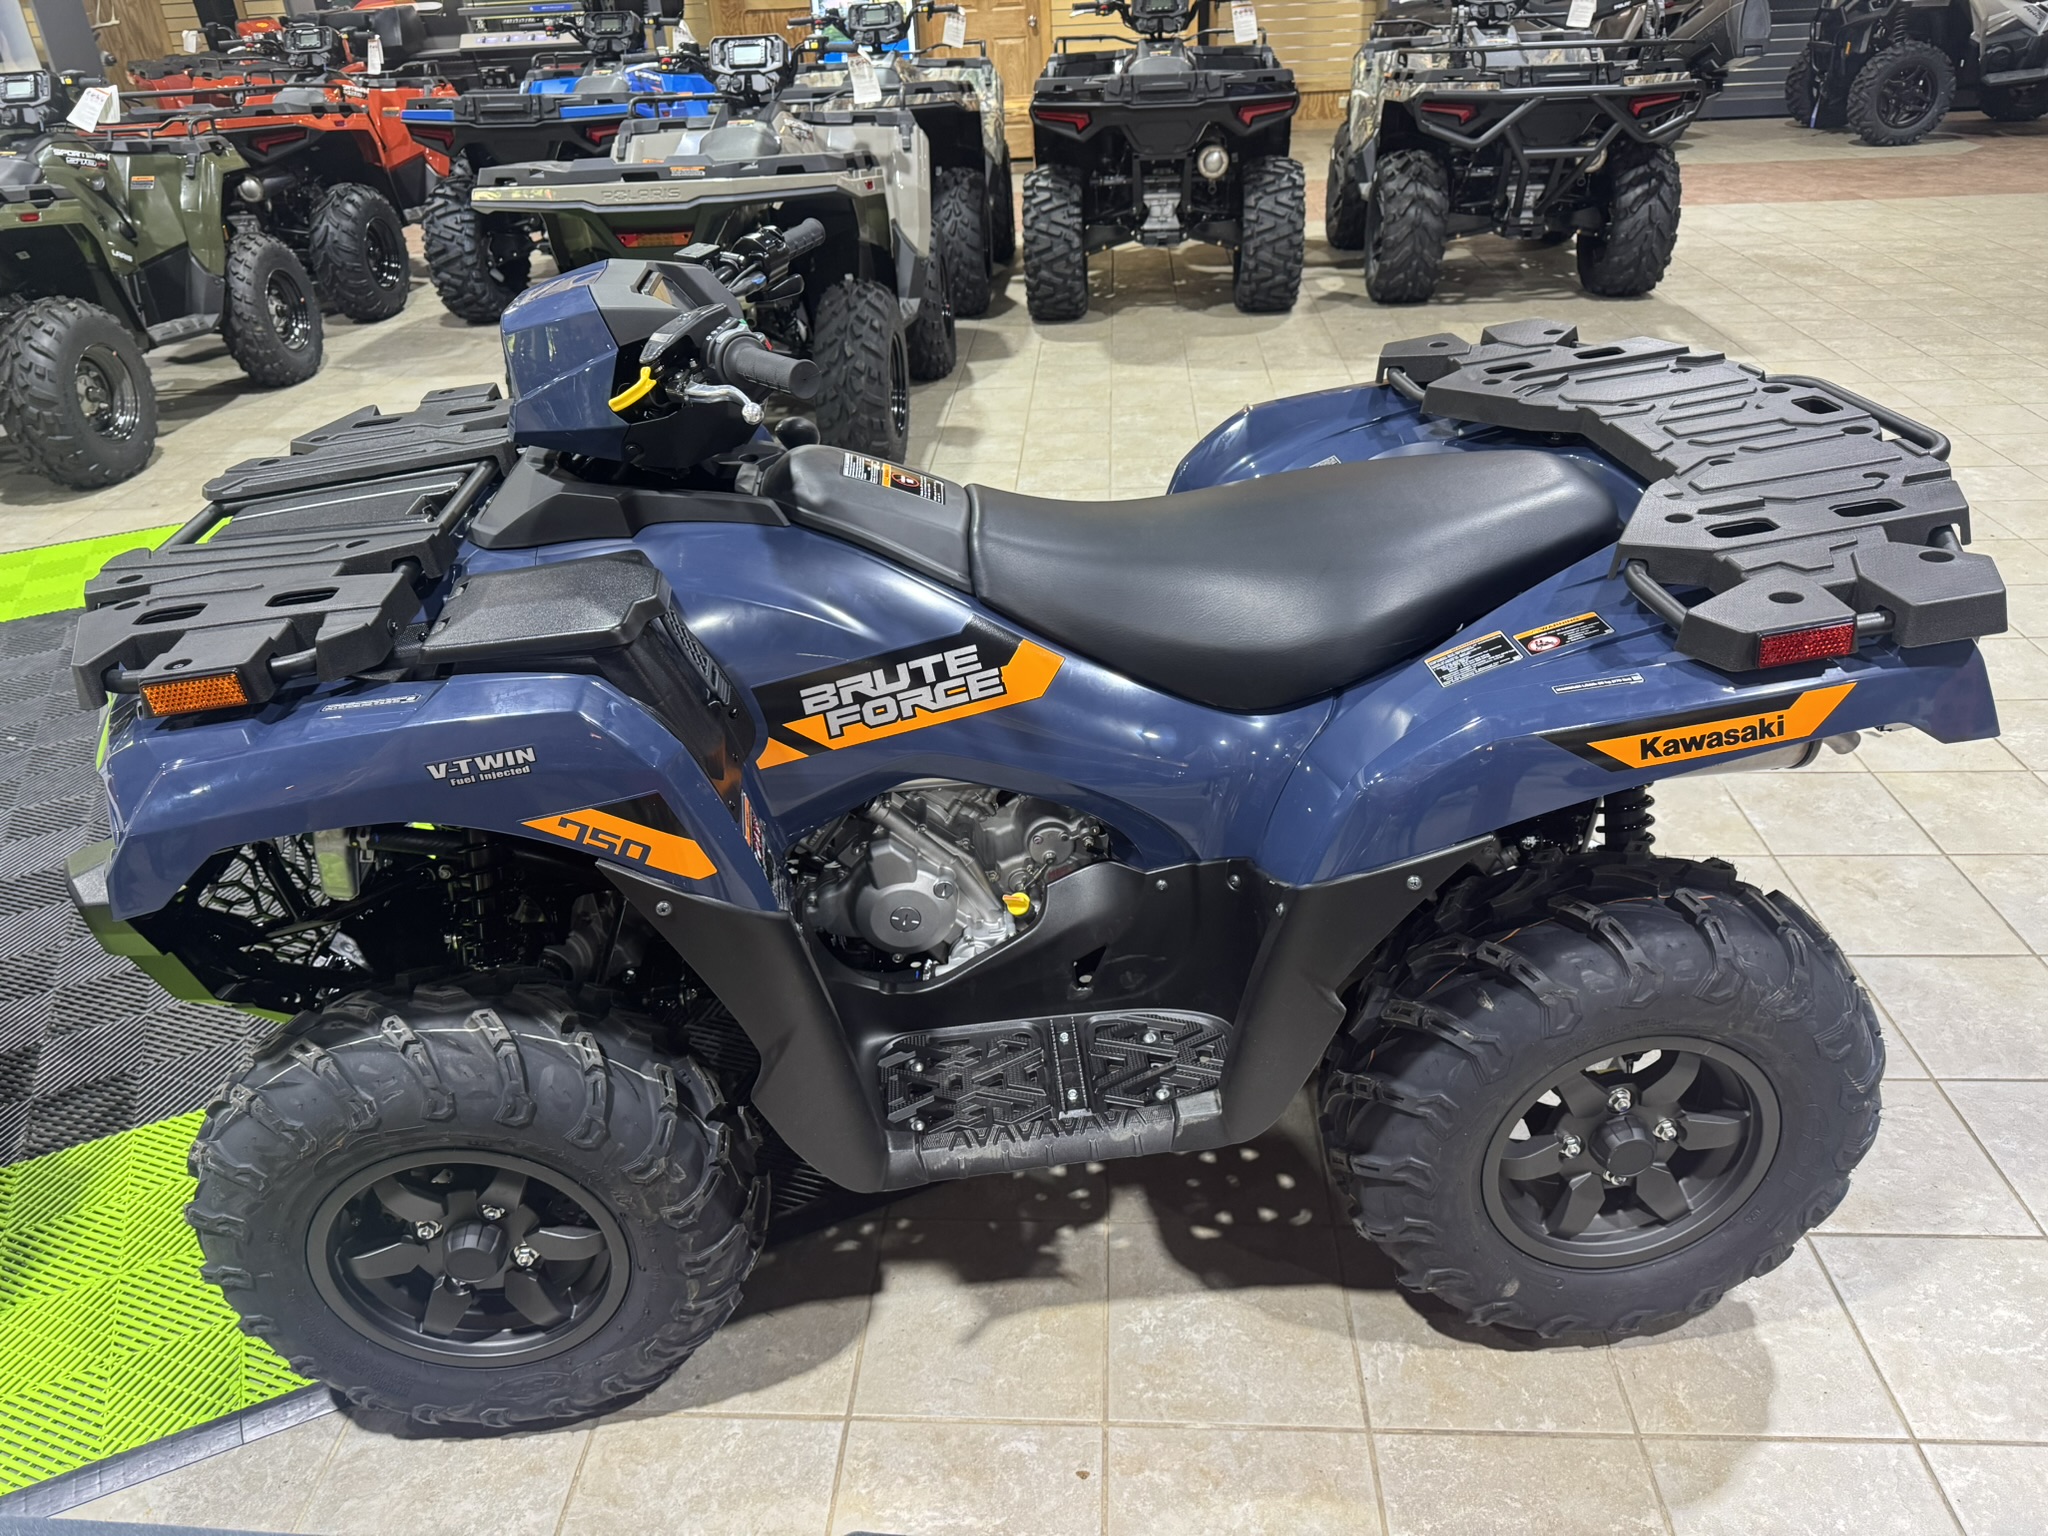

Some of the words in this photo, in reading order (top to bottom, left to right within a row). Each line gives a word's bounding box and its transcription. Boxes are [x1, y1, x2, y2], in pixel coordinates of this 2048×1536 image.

[601, 187, 681, 201] POLARIS
[800, 644, 982, 715] BRUTE
[827, 667, 1004, 736] FORCE
[1640, 714, 1785, 760] Kawasaki
[426, 747, 536, 780] V-TWIN
[450, 775, 475, 787] Fuel
[479, 764, 531, 781] Injected
[558, 817, 652, 865] 750
